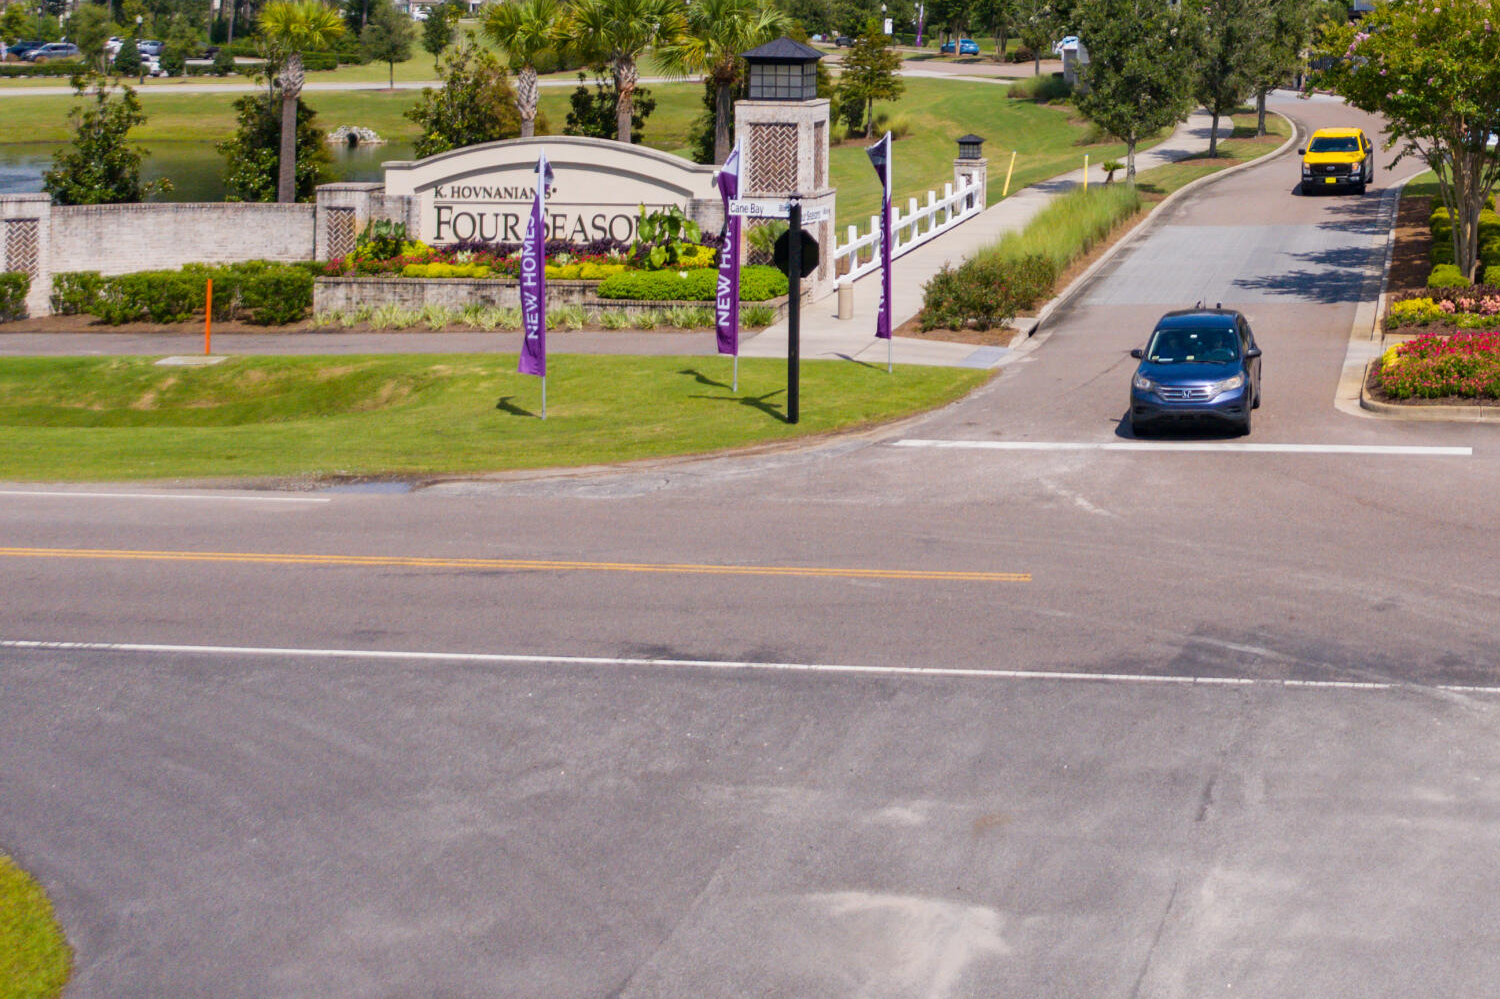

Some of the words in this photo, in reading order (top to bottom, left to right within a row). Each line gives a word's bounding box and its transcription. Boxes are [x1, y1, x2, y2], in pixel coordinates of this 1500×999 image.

[434, 186, 447, 199] K.
[730, 203, 749, 214] Cane
[751, 203, 764, 215] Bay
[433, 205, 522, 242] FOUR
[525, 292, 539, 340] NEW
[717, 275, 731, 327] NEW
